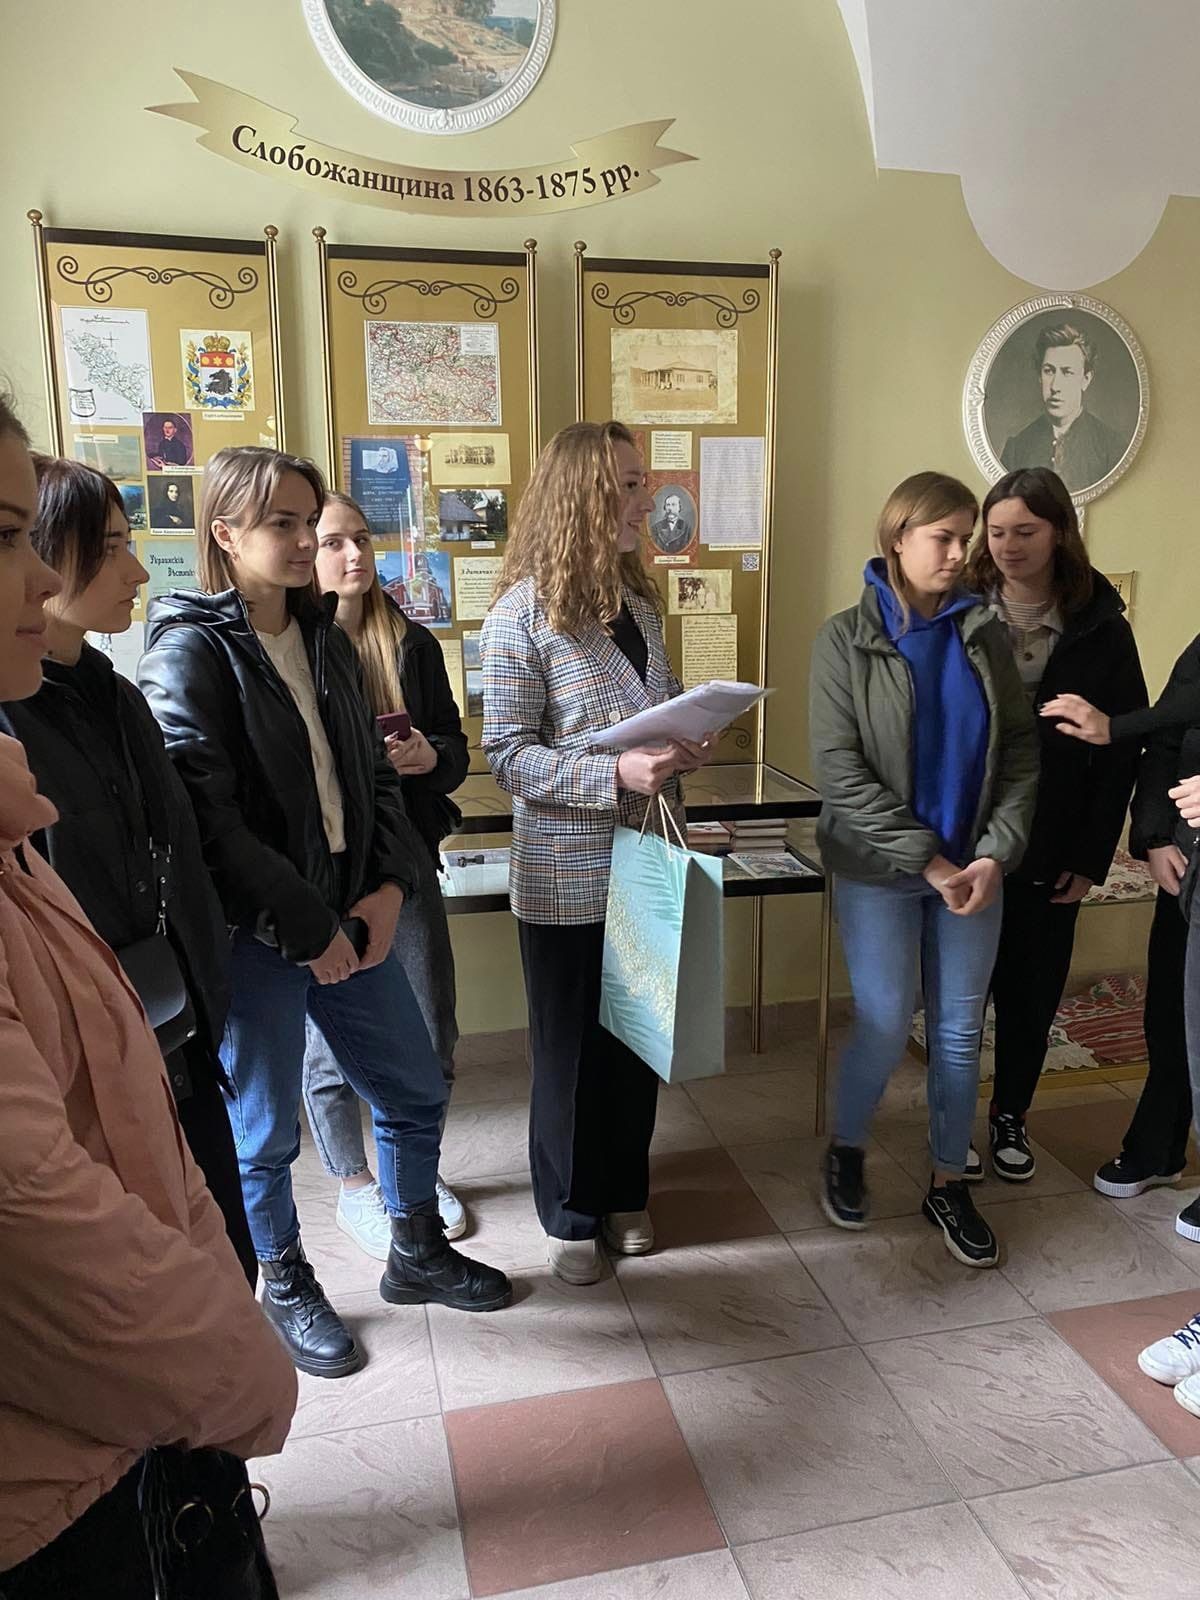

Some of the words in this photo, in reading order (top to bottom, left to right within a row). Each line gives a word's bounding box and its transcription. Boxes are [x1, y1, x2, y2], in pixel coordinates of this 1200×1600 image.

[232, 125, 455, 200] Слобожанщина
[463, 167, 597, 203] 1863-1875
[600, 163, 640, 198] рр.
